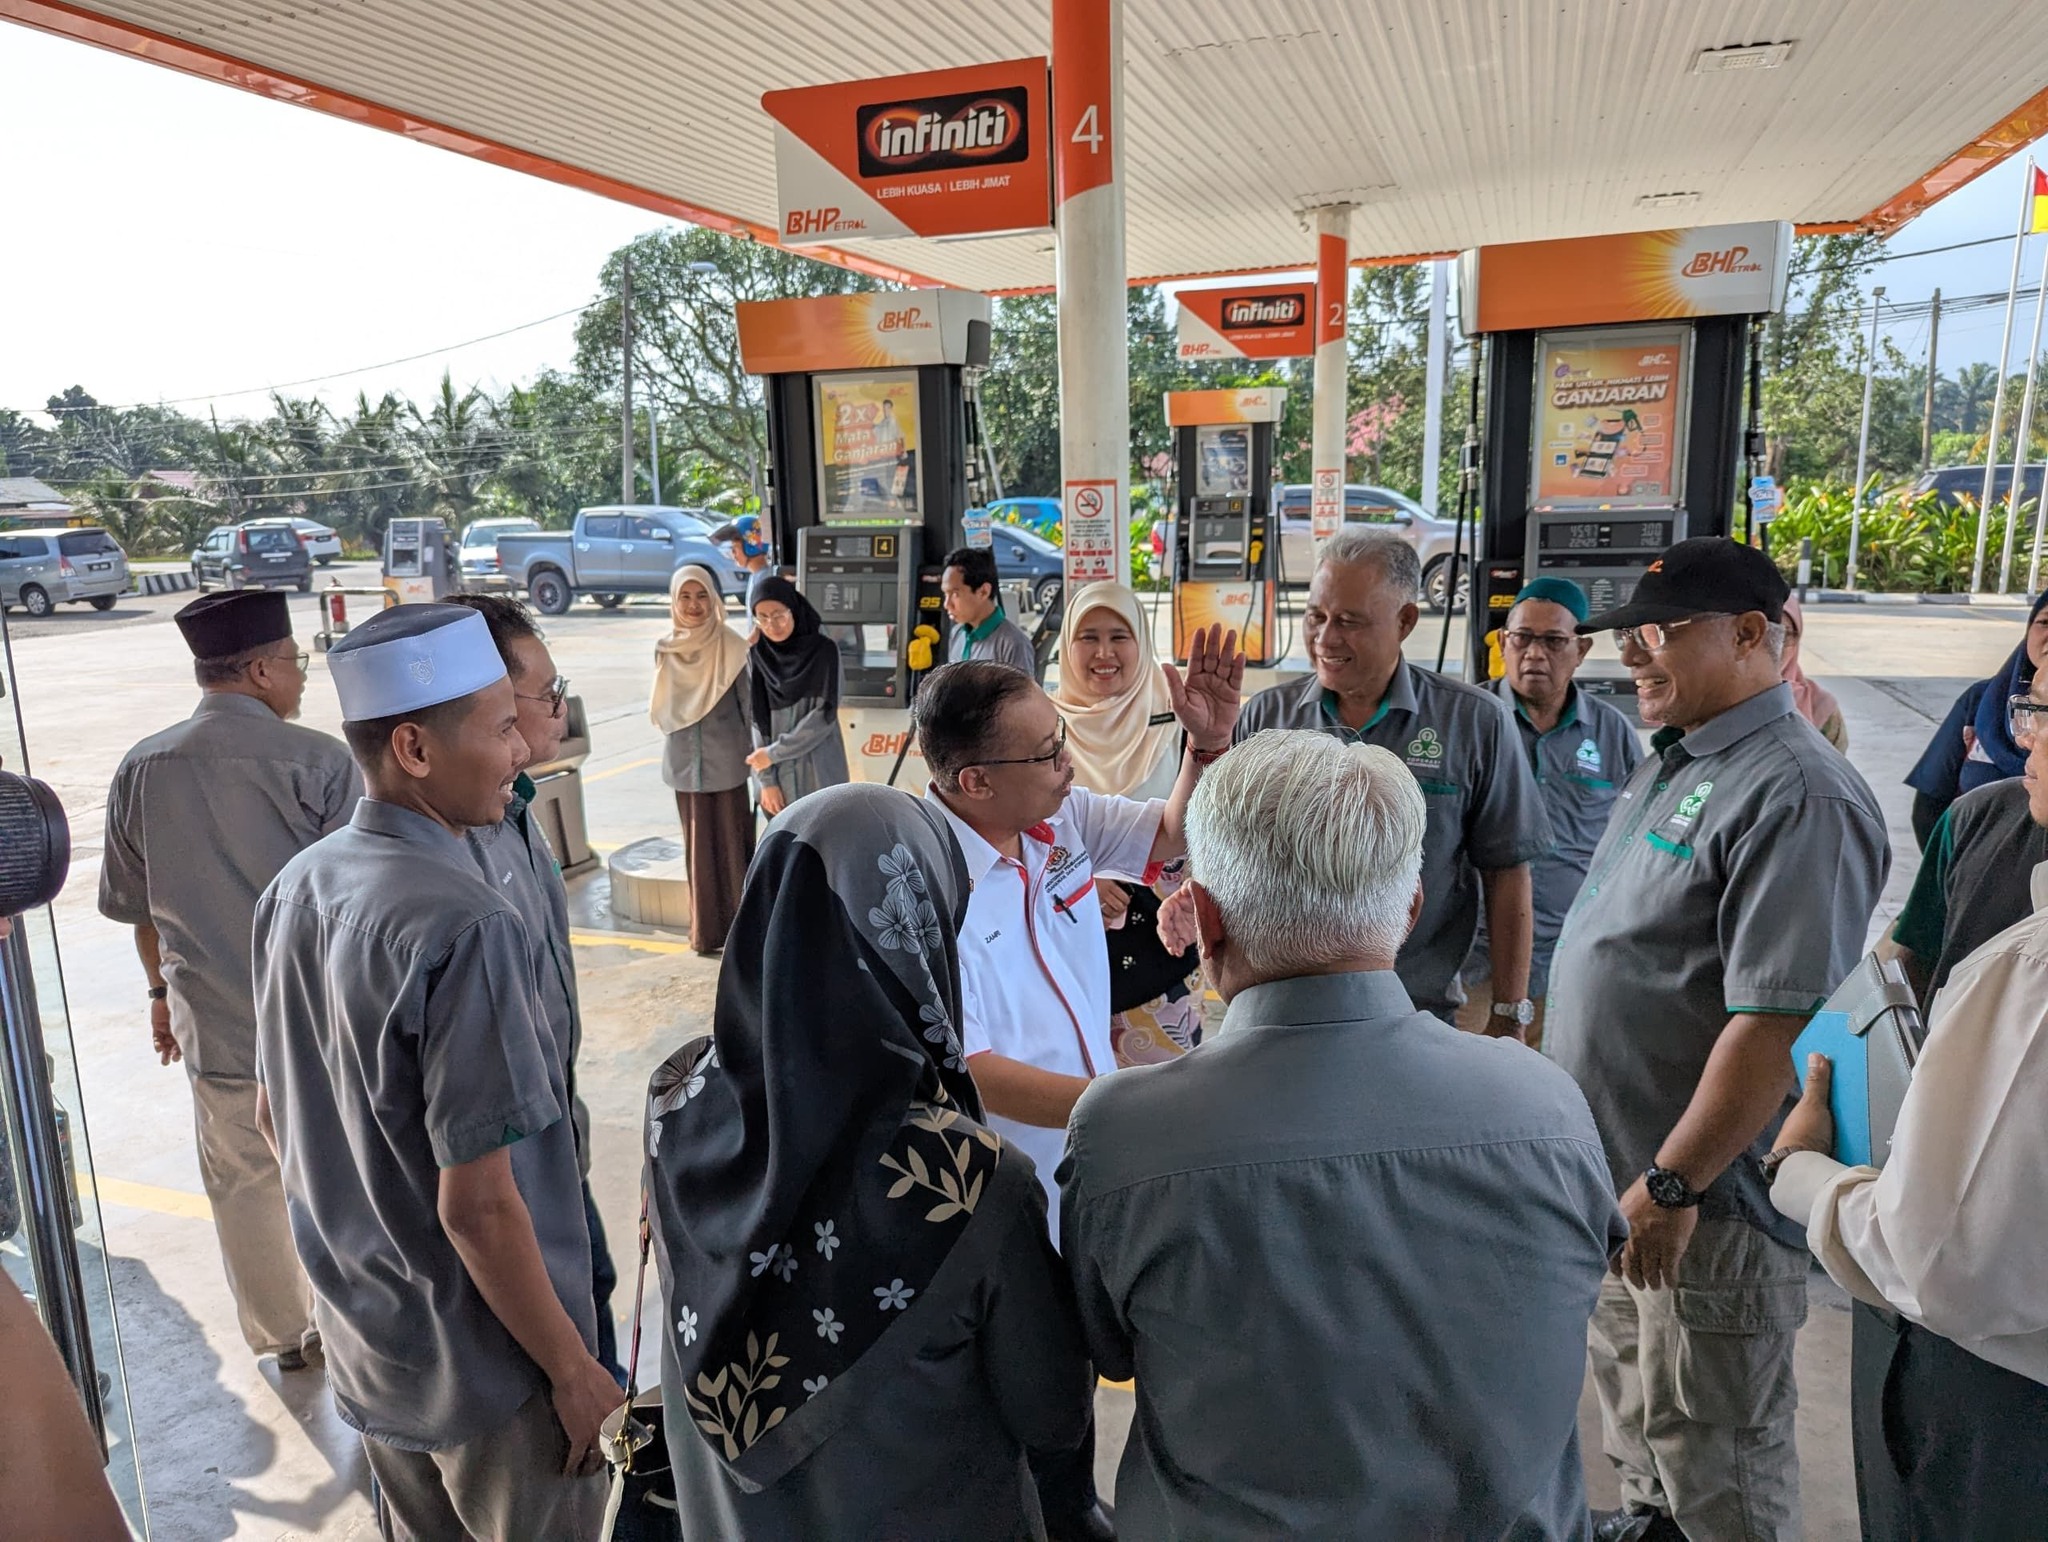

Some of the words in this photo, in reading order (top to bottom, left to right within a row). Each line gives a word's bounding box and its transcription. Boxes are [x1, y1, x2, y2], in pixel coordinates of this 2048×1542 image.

[880, 104, 1005, 157] infiniti
[1071, 105, 1104, 154] 4
[876, 187, 906, 199] LEBIH
[906, 183, 942, 196] KUASA
[949, 179, 980, 192] LEBIH
[981, 175, 1011, 189] JIMAT
[1231, 300, 1295, 322] infiniti
[1328, 303, 1343, 326] 2
[1552, 384, 1668, 407] GANJARAN
[838, 404, 853, 426] 2
[836, 429, 871, 444] Mata
[834, 441, 898, 462] Ganjaran
[880, 541, 888, 552] 4
[920, 597, 941, 608] 95
[1488, 595, 1515, 608] 95
